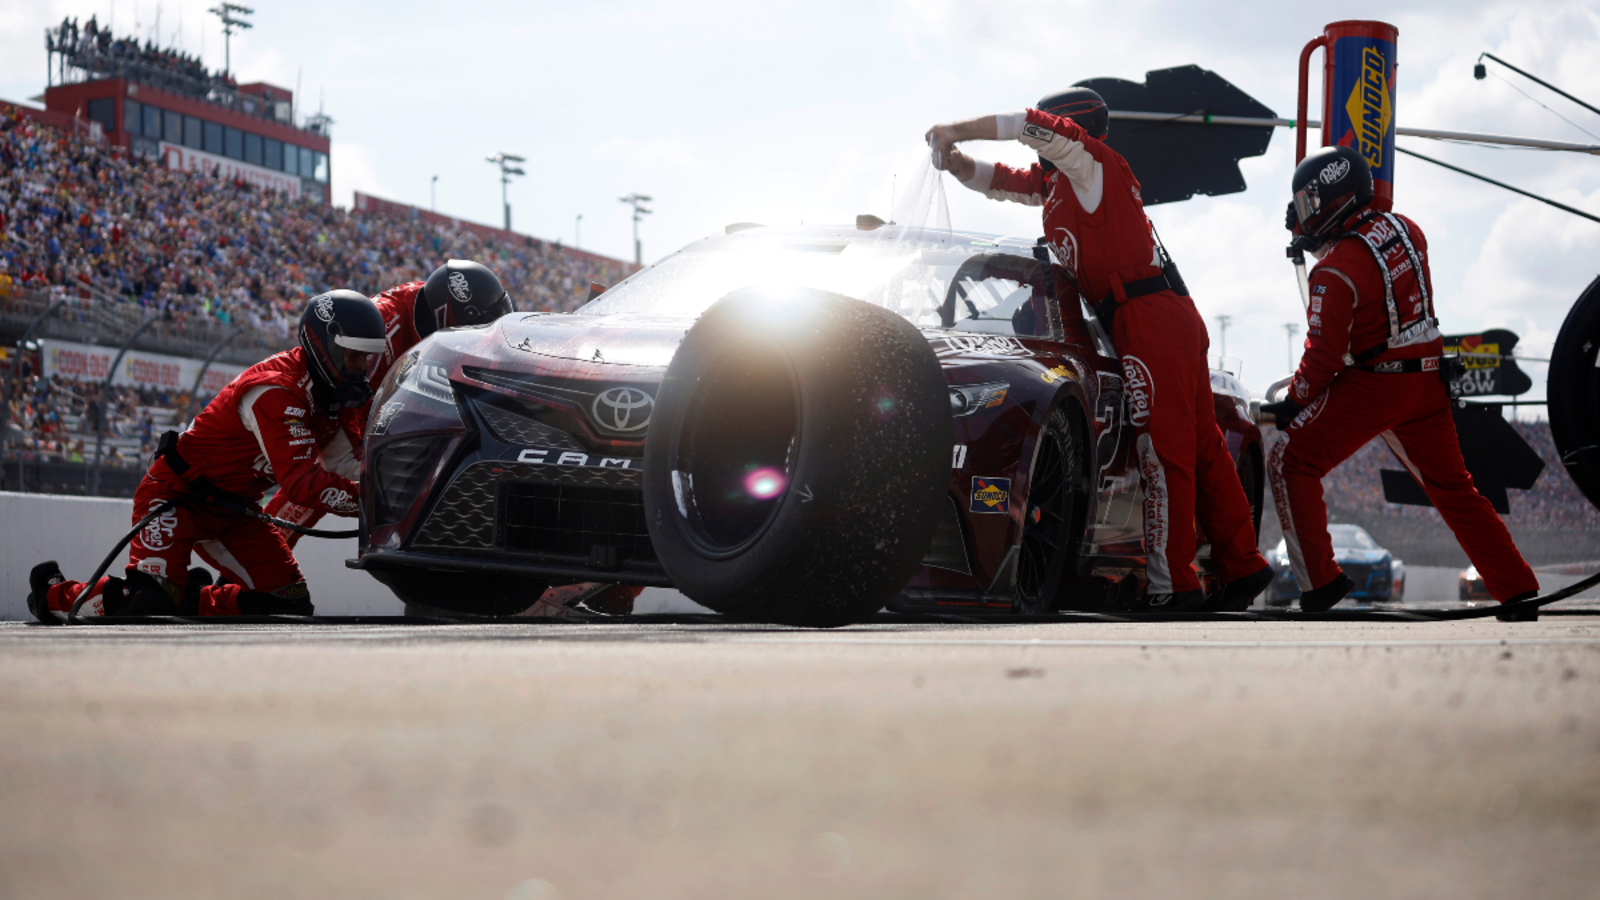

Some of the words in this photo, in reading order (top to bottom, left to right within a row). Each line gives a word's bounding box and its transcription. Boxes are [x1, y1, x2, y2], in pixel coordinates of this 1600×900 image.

[1361, 52, 1384, 163] SUNOCO
[163, 146, 298, 196] DARINGTON
[1320, 160, 1348, 184] Pepper
[1327, 160, 1339, 171] Dr
[448, 272, 468, 300] Pepper
[58, 349, 88, 375] COOK
[89, 354, 110, 377] OUT
[132, 358, 160, 383] COOK
[162, 363, 180, 386] OUT
[1450, 380, 1495, 393] NOW
[1460, 369, 1495, 382] XIT
[1123, 361, 1150, 427] Pepper
[320, 487, 358, 509] Pepper
[336, 490, 352, 501] Dr
[975, 491, 1007, 500] SUNOCO
[160, 515, 178, 537] Dr
